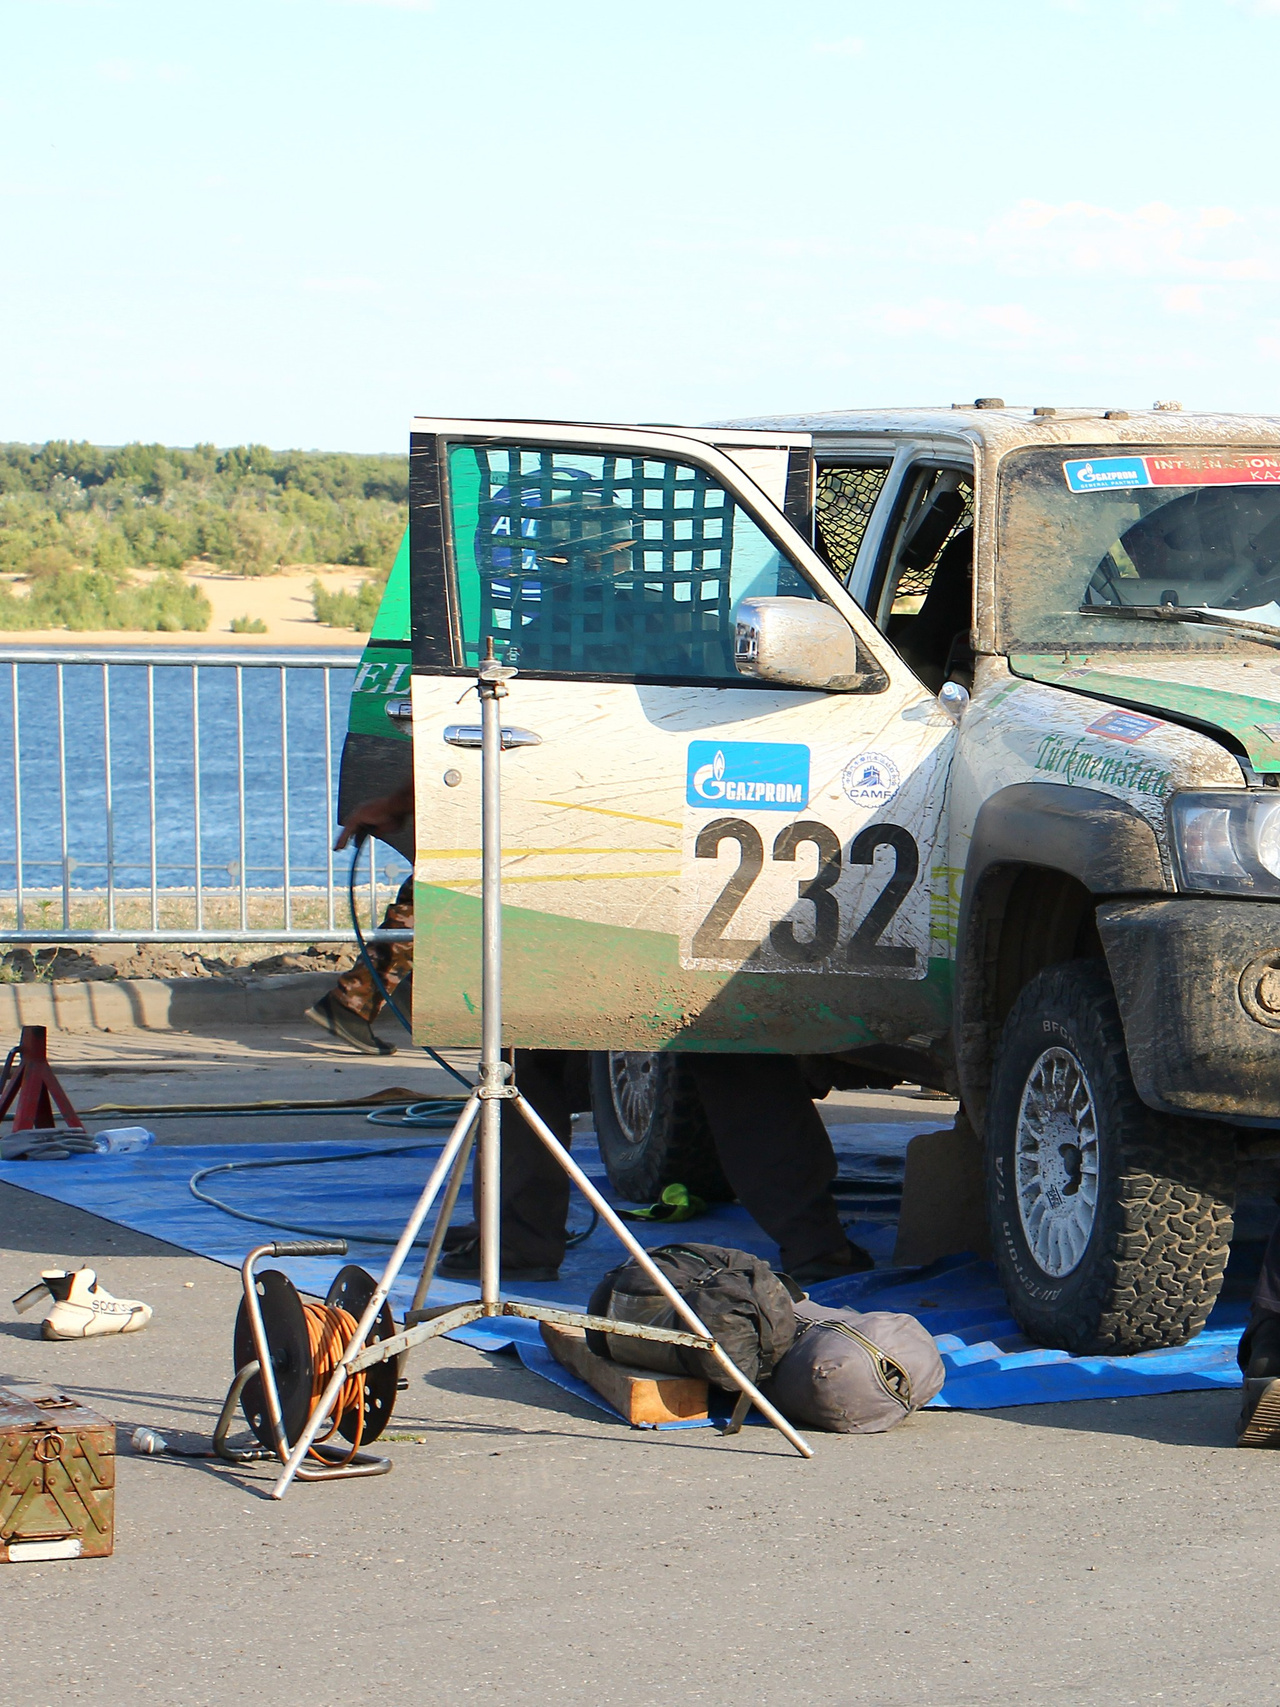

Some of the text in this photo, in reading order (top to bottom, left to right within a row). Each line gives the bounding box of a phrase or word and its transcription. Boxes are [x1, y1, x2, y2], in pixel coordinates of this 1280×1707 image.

[1095, 471, 1138, 481] GAZPROM
[1080, 479, 1140, 489] GENERAL PARTNER
[725, 780, 803, 804] GAZPROM
[849, 789, 893, 800] CAMF
[692, 817, 920, 968] 232
